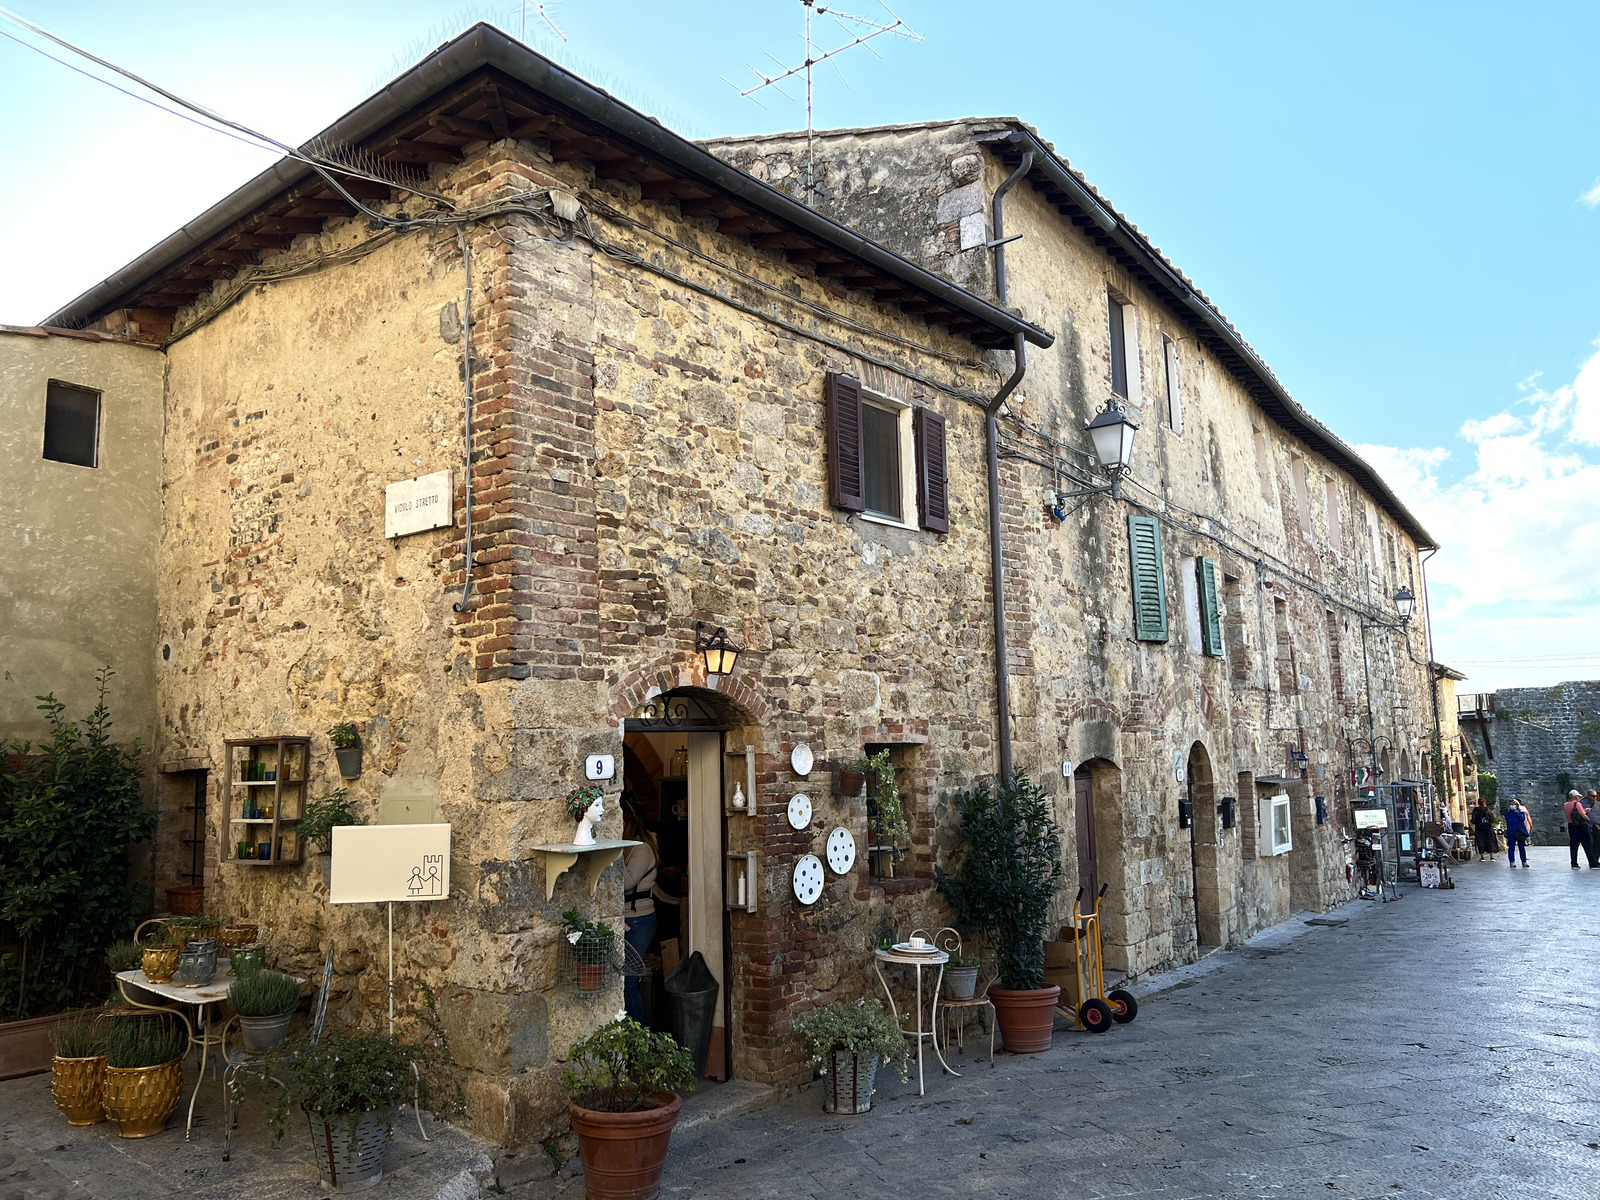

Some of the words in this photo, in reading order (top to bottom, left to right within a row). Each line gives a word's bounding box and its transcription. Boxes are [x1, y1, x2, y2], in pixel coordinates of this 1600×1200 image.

[394, 501, 413, 514] VICOLO
[415, 494, 439, 508] STRETTO
[596, 759, 603, 775] 9
